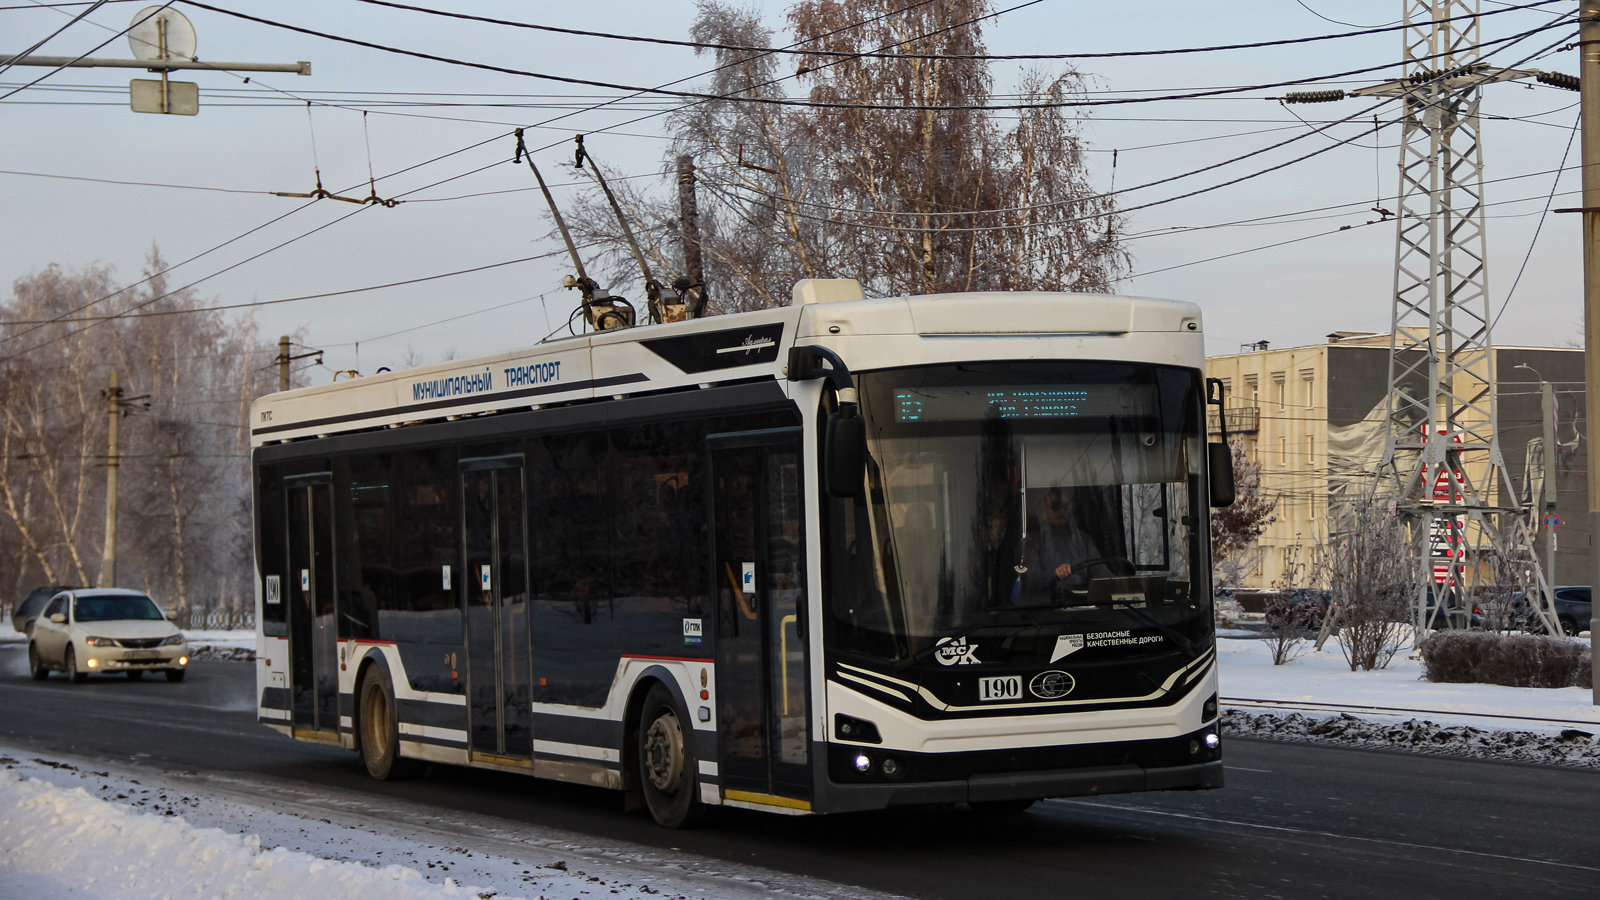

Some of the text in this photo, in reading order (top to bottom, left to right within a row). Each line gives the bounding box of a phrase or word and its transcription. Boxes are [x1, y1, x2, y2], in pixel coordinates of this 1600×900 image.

[412, 361, 561, 401] МУНИЦИПАЛЬНЫЙ ТРАНСПОРТ
[267, 578, 279, 601] 190
[1086, 630, 1131, 640] БЕЗОПАСНЫЕ
[1086, 636, 1164, 648] КАЧЕСТВЕННЫЕ ДОРОГИ
[982, 677, 1019, 699] 190
